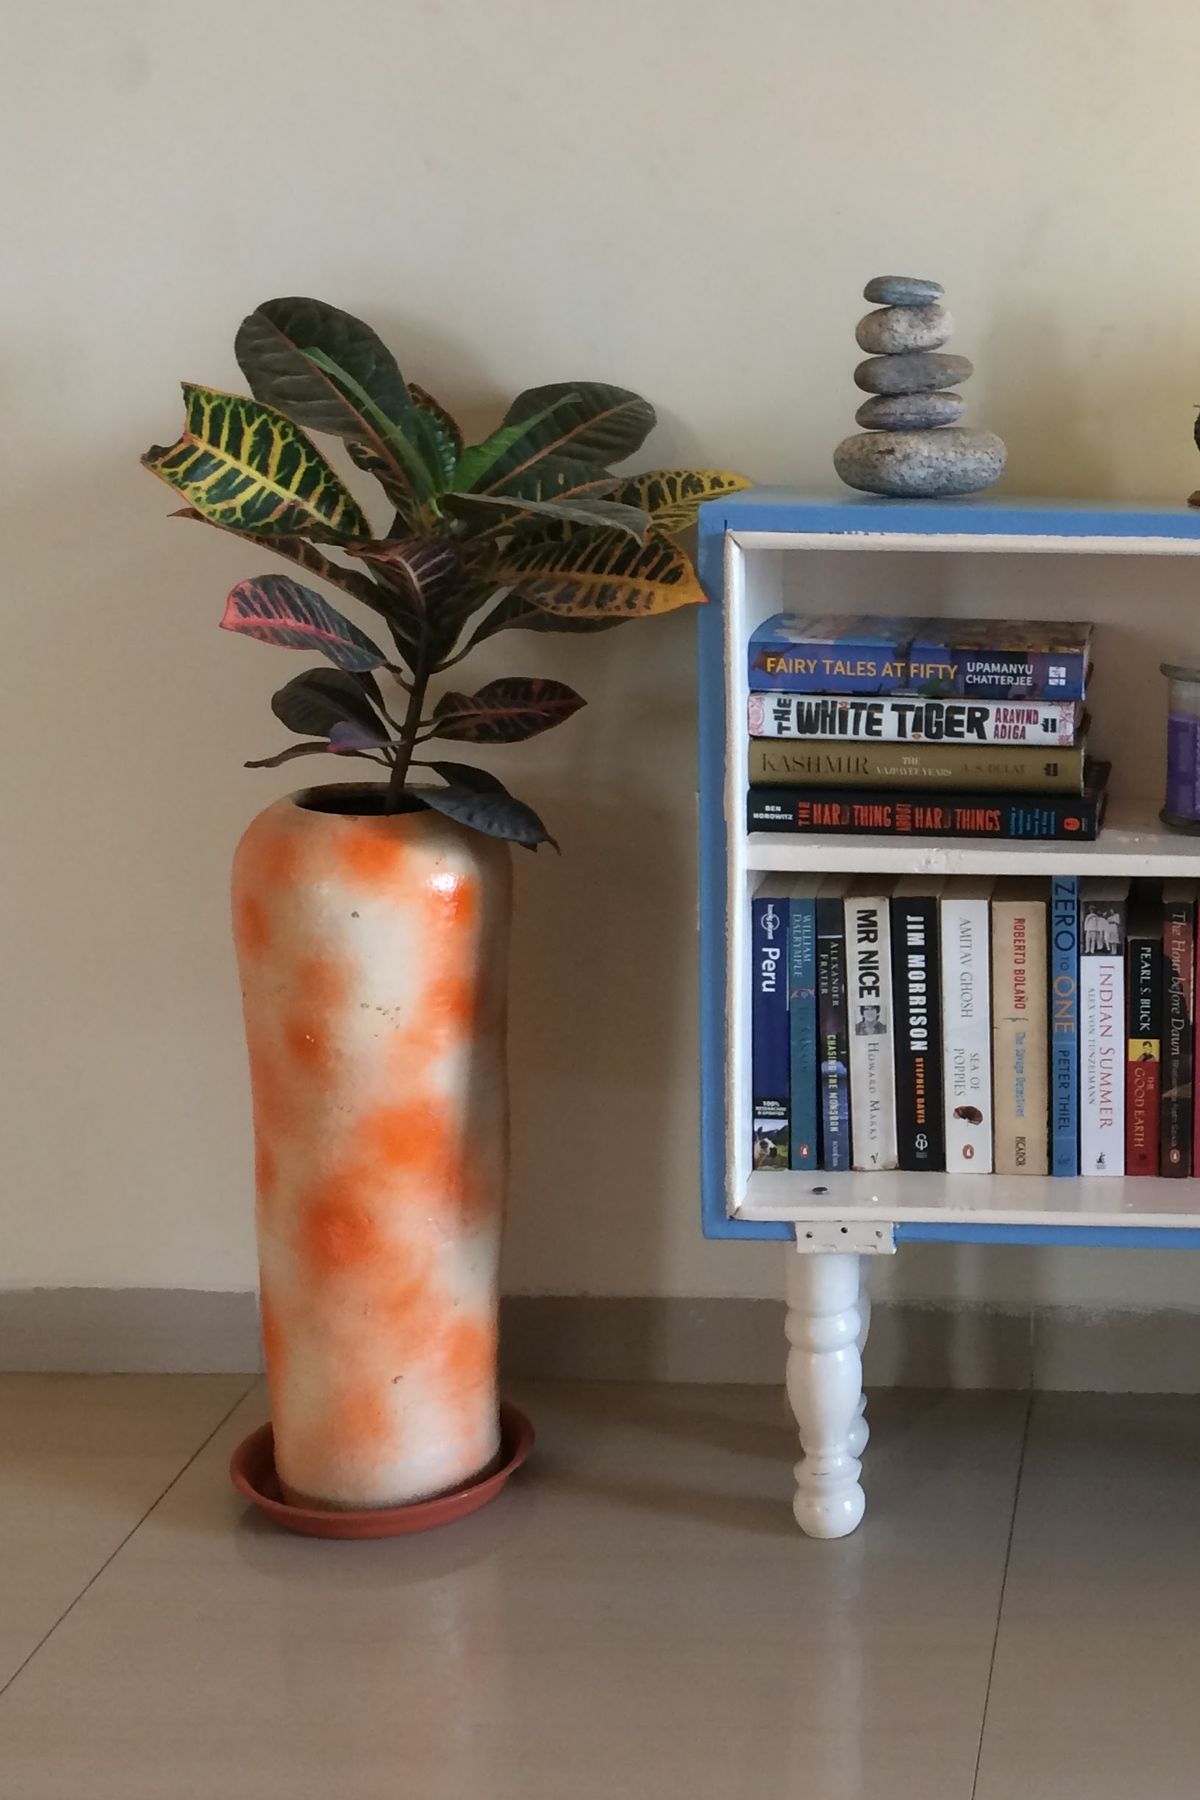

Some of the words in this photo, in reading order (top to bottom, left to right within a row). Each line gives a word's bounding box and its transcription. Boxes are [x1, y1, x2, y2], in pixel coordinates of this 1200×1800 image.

[765, 656, 818, 675] FAIRY
[822, 659, 876, 677] TALES
[881, 661, 905, 678] AT
[909, 663, 958, 680] FIFTY
[965, 674, 1033, 687] CHATTERJEE
[966, 661, 1034, 675] UPAMANYU
[772, 697, 793, 735] THE
[796, 699, 884, 737] WHITE
[891, 702, 991, 741] TIGER
[993, 725, 1027, 741] ADIGA
[994, 707, 1039, 725] ARAVIND
[761, 752, 869, 776] KASHMIR
[852, 804, 891, 828] THING
[955, 808, 1001, 832] THINGS
[857, 909, 878, 944] MR
[906, 915, 926, 946] JIM
[1054, 881, 1076, 952] ZERO
[1171, 912, 1187, 936] The
[793, 914, 803, 977] DALRYMPLE
[802, 914, 812, 962] WILLIAM
[959, 917, 972, 967] AMITAV
[1013, 917, 1026, 965] ROBERTO
[1170, 939, 1187, 967] Hour
[762, 947, 780, 992] Peru
[820, 953, 829, 995] FRATER
[830, 941, 840, 1007] ALEXANDER
[858, 950, 880, 999] NICE
[1058, 956, 1069, 971] TO
[1140, 946, 1152, 983] PEARL
[907, 954, 928, 1051] MORRISON
[960, 971, 973, 1018] GHOSH
[1014, 968, 1028, 1010] BOLAÑO
[1053, 975, 1076, 1033] ONE
[1087, 987, 1096, 1010] ALEX
[1099, 965, 1115, 1038] INDIAN
[1168, 971, 1187, 1015] before
[1139, 998, 1151, 1031] BUCK
[826, 1034, 837, 1072] CHASING
[1170, 1018, 1186, 1056] Dawn
[867, 1042, 879, 1094] HOWARD
[915, 1057, 925, 1095] STEPHEN
[953, 1048, 966, 1097] POPPIES
[969, 1052, 980, 1072] SEA
[1058, 1050, 1071, 1089] PETER
[828, 1074, 838, 1089] THE
[970, 1077, 980, 1090] OF
[1098, 1047, 1115, 1129] SUMMER
[1133, 1067, 1146, 1107] GOOD
[828, 1092, 839, 1132] MONSOON
[869, 1100, 880, 1140] MARKS
[916, 1096, 926, 1125] DAVIS
[1058, 1095, 1071, 1131] THIEL
[1133, 1111, 1145, 1148] EARTH
[1015, 1136, 1027, 1167] PICADOR
